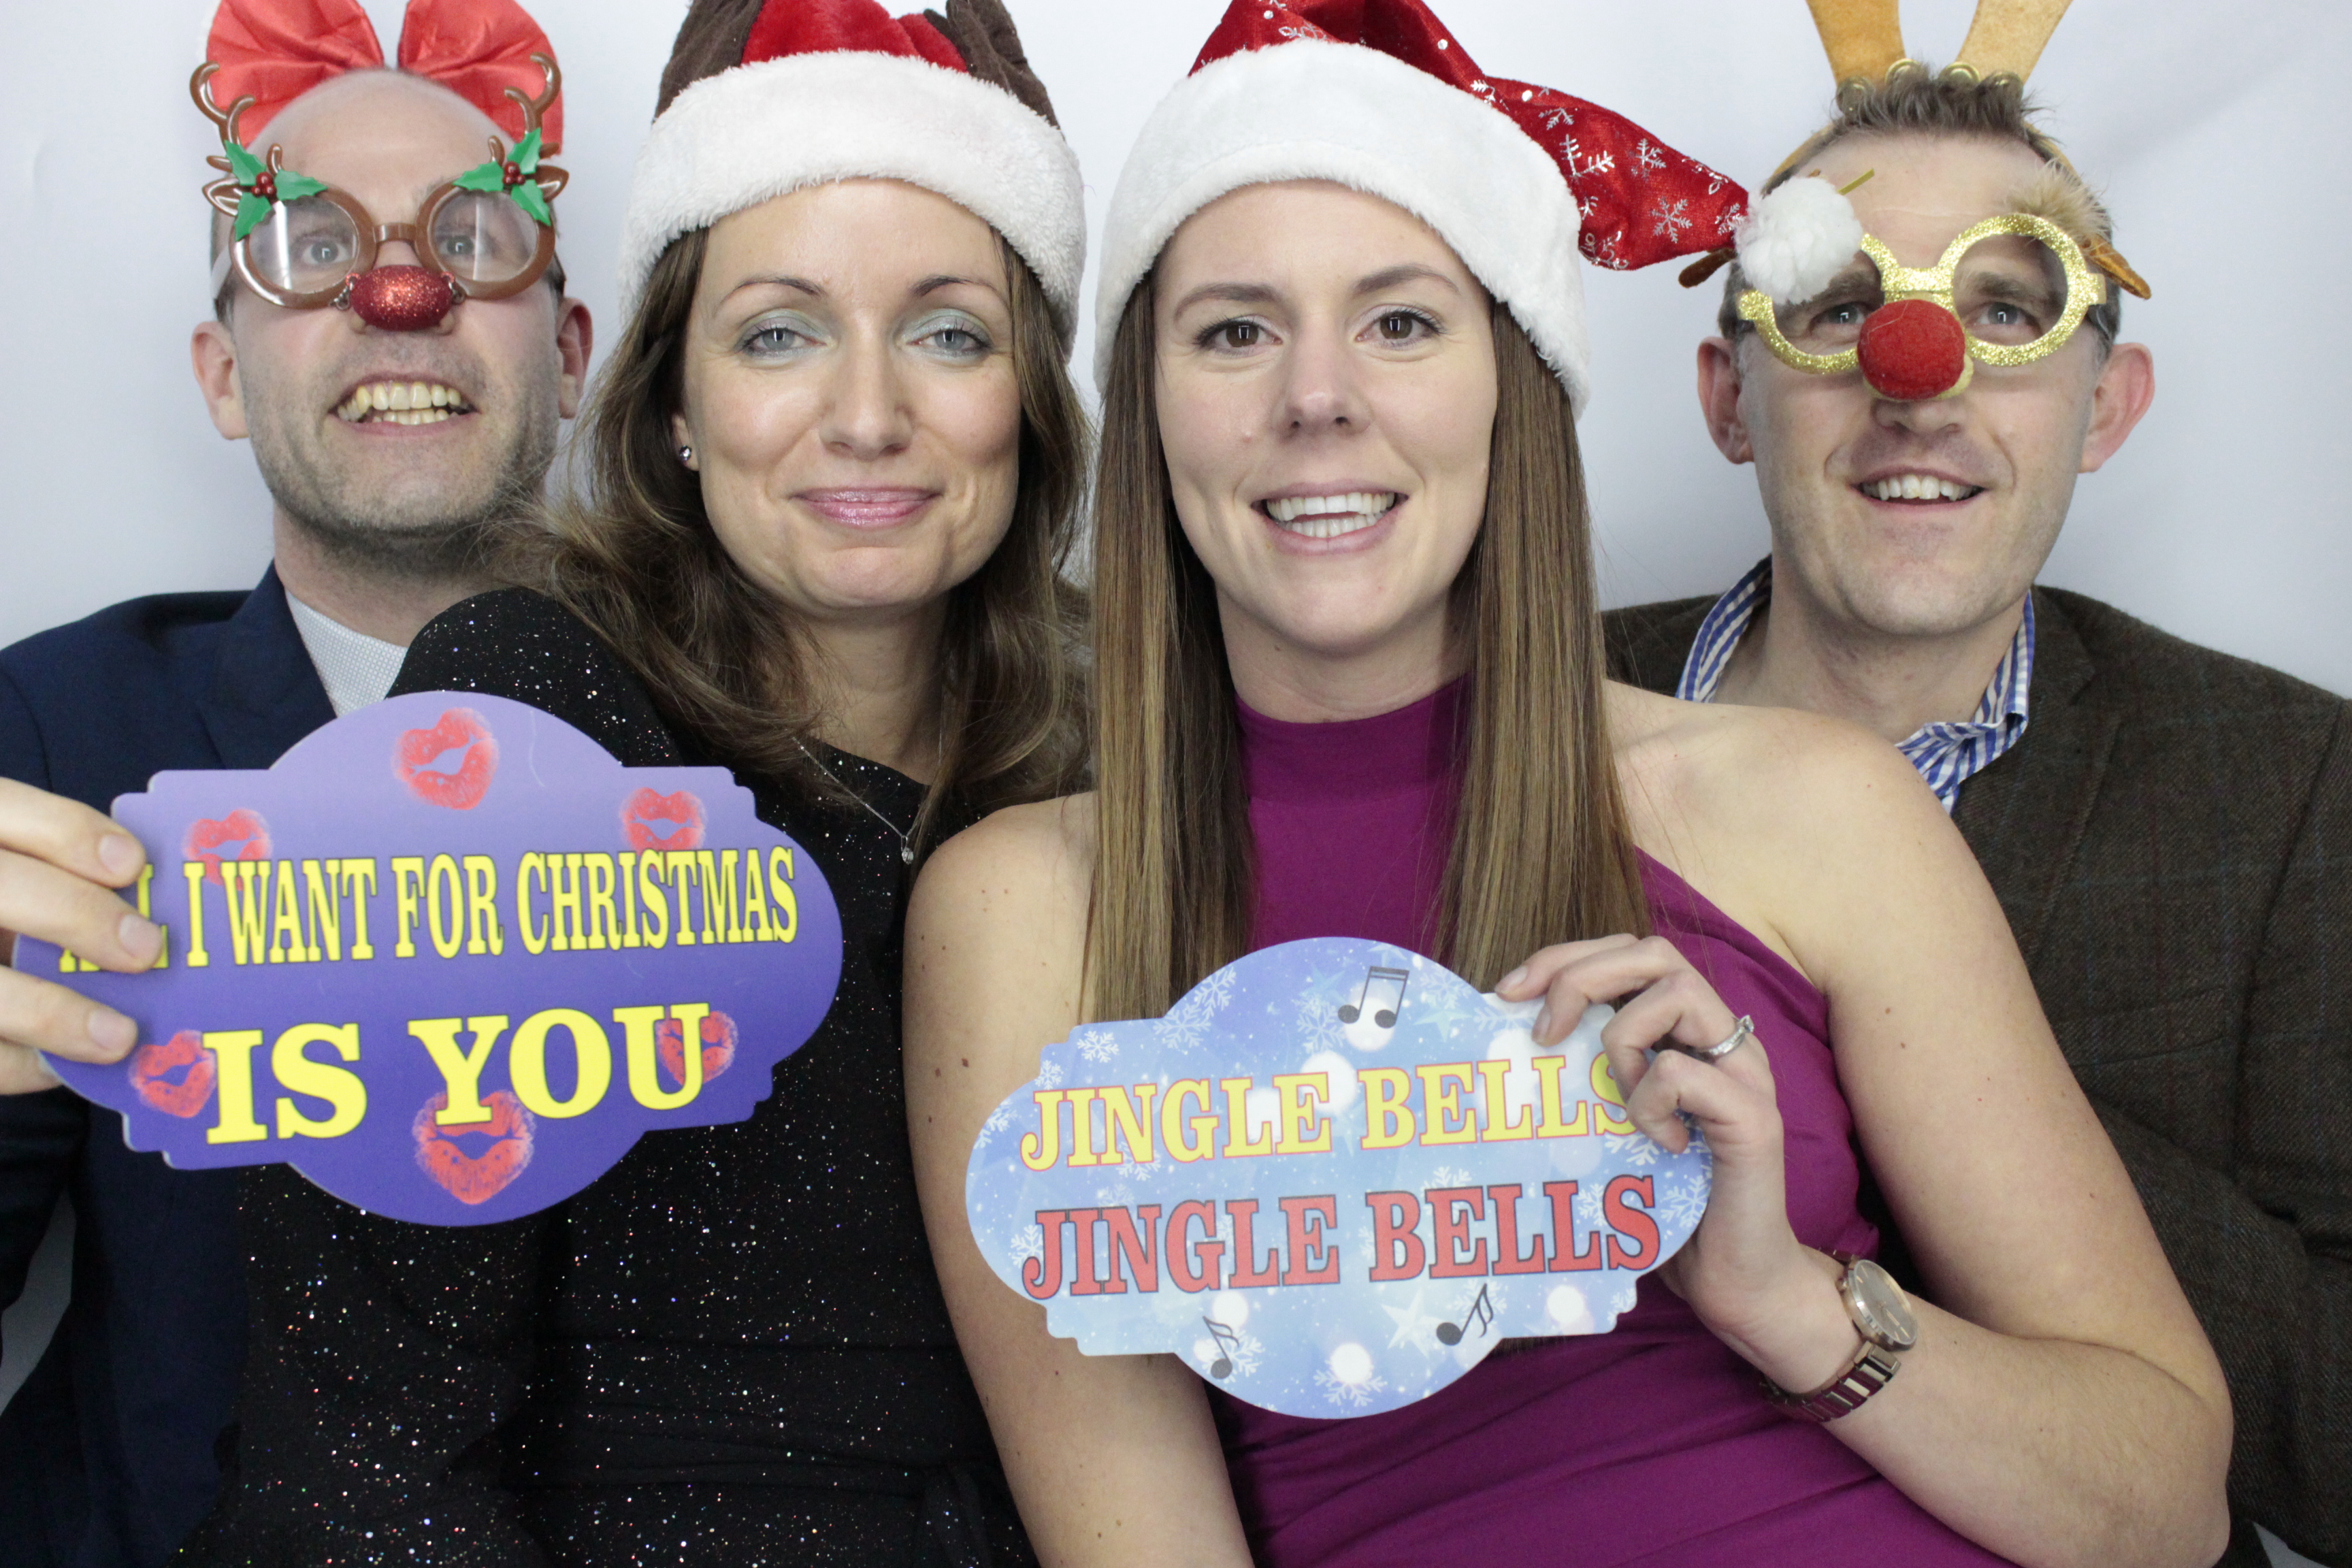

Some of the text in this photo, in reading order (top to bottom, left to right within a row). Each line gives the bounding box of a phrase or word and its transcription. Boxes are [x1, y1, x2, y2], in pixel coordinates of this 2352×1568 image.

[183, 860, 209, 968] I
[220, 857, 378, 965] WANT
[391, 853, 504, 959] FOR
[516, 845, 799, 956] CHRISTMAS
[202, 1002, 712, 1145] IS YOU
[1019, 1050, 1639, 1172] JINGLE BELLS
[1021, 1175, 1661, 1300] JINGLE BELLS
